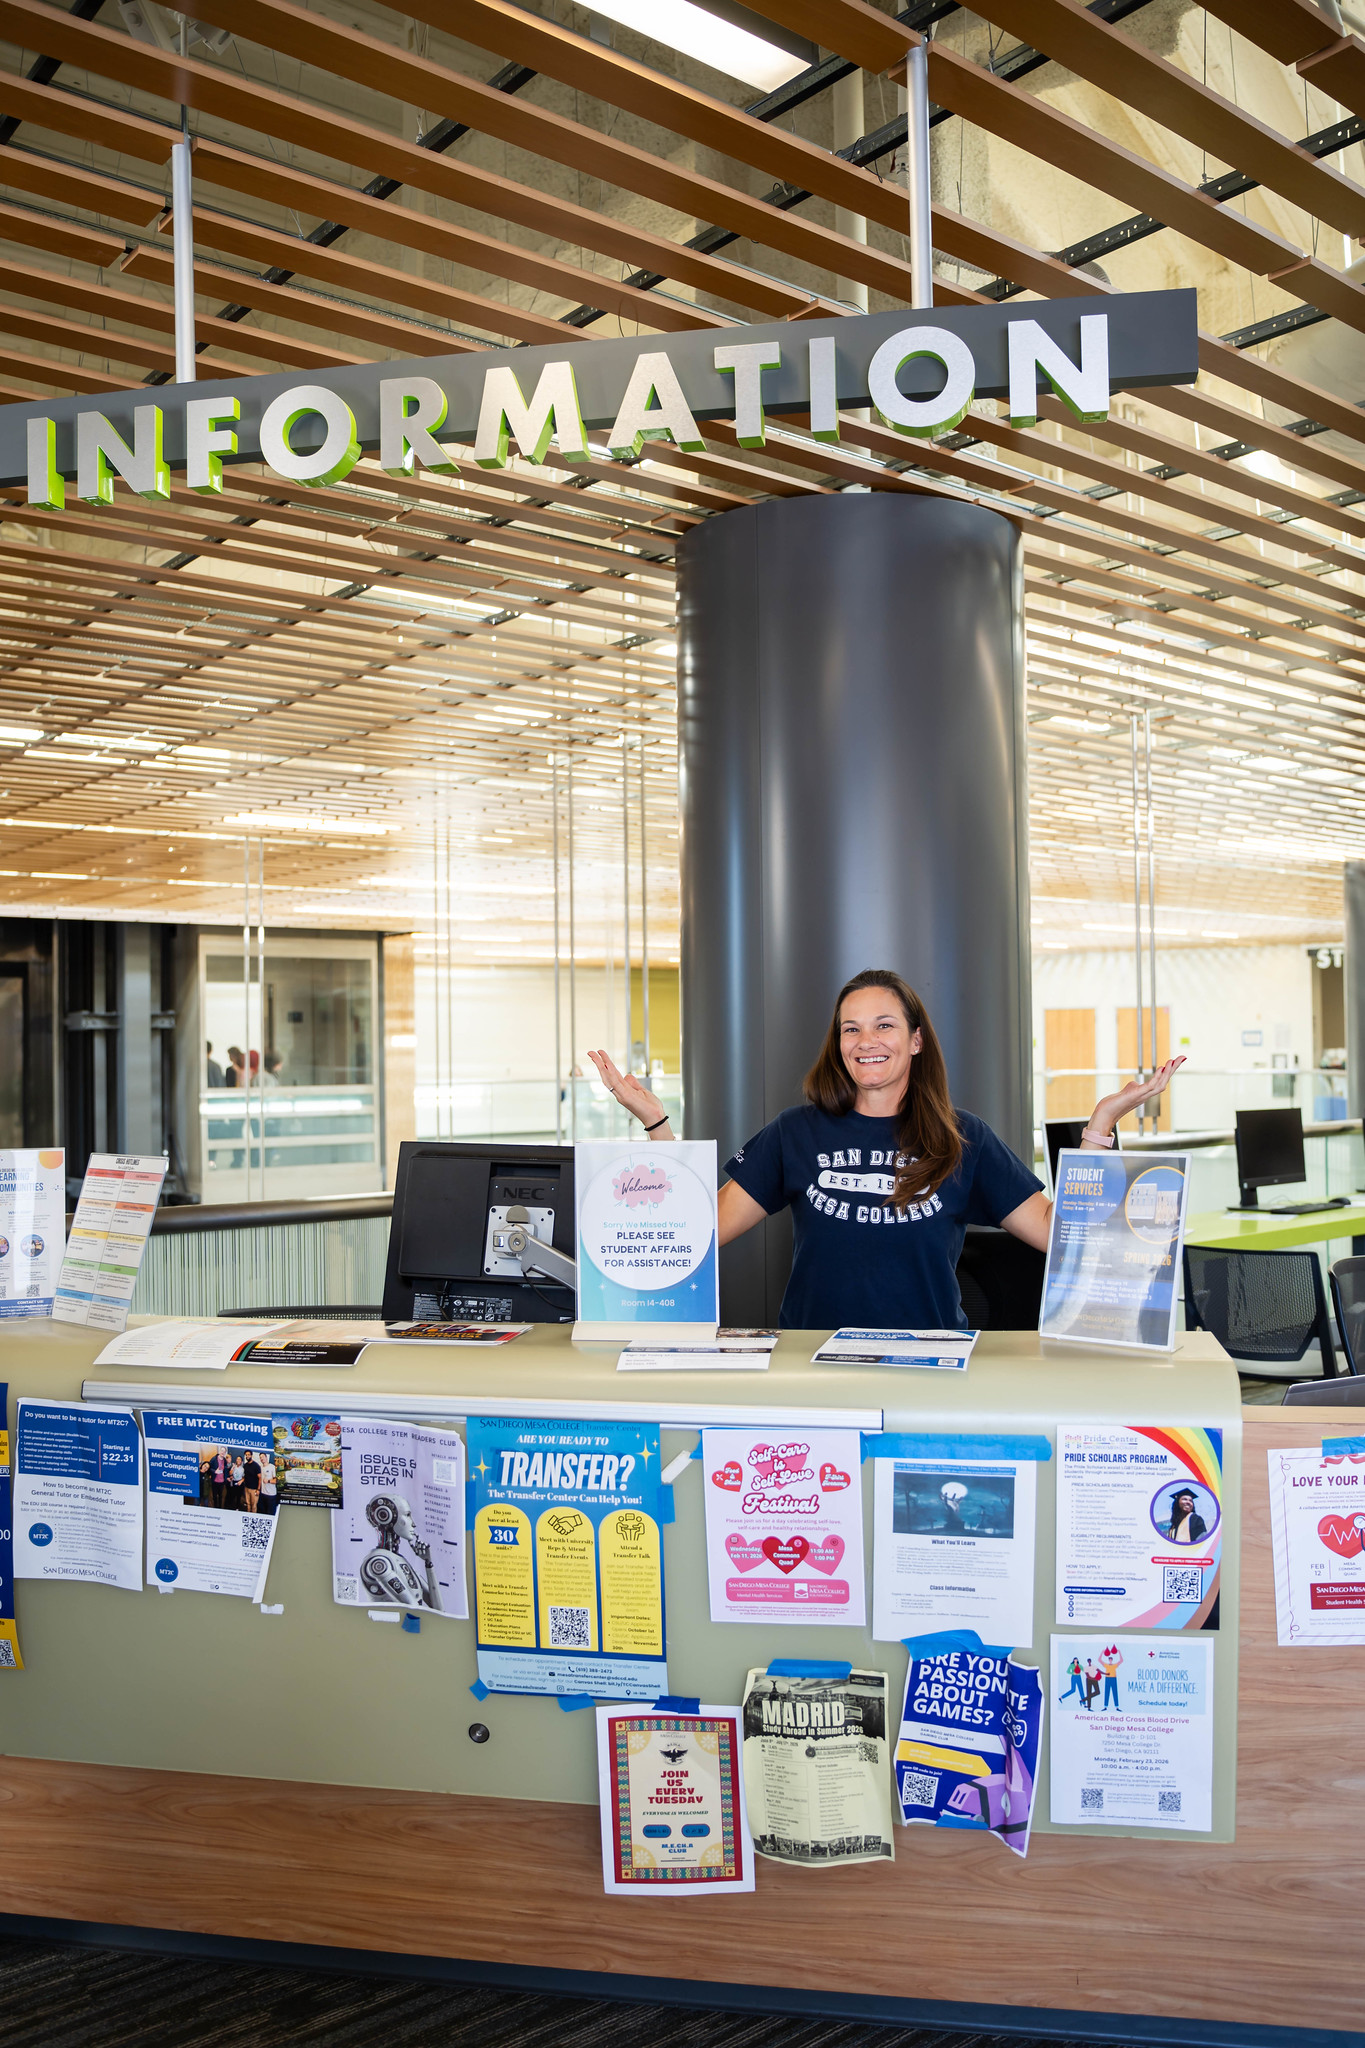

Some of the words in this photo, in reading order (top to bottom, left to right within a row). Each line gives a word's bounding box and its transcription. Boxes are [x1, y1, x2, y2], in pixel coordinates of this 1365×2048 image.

[27, 313, 1110, 511] INFORMATION
[816, 1148, 862, 1169] SAN
[869, 1150, 919, 1169] DIE
[1066, 1168, 1105, 1182] STUDENT
[621, 1178, 665, 1195] Welcome
[828, 1174, 868, 1188] EST.
[877, 1178, 906, 1190] 19
[503, 1187, 545, 1201] NEC
[1063, 1182, 1104, 1196] SERVICES
[806, 1183, 850, 1221] MESA
[855, 1192, 943, 1224] COLLEGE
[603, 1221, 623, 1229] Sorry
[617, 1232, 654, 1240] PLEASE
[656, 1232, 675, 1240] SEE
[600, 1245, 646, 1253] STUDENT
[650, 1245, 692, 1253] AFFAIRS
[604, 1259, 624, 1267] FOR
[627, 1259, 691, 1267] ASSISTANCE!
[621, 1299, 646, 1307] Room
[82, 1416, 96, 1424] tutor
[107, 1419, 129, 1427] MT2C?
[157, 1417, 184, 1426] FREE
[186, 1418, 217, 1428] MT2C
[219, 1420, 268, 1436] Tutoring
[480, 1418, 497, 1428] SAN
[498, 1419, 524, 1430] DIEGO
[524, 1421, 547, 1430] MESA
[547, 1421, 580, 1430] COLLEGE
[195, 1434, 209, 1442] SAN
[208, 1435, 228, 1444] DIEGO
[227, 1437, 244, 1446] MESA
[243, 1439, 268, 1447] COLLEGE
[342, 1427, 355, 1435] ESA
[358, 1428, 387, 1436] COLLEGE
[391, 1430, 408, 1438] STEM
[411, 1433, 436, 1444] READERS
[439, 1438, 457, 1447] CLUB
[517, 1434, 537, 1444] ARE
[538, 1435, 557, 1445] YOU
[557, 1436, 592, 1445] READY
[593, 1437, 609, 1446] TO
[102, 1453, 134, 1463] $22.31
[151, 1452, 169, 1460] Mesa
[169, 1454, 197, 1463] Tutoring
[360, 1454, 407, 1467] ISSUES
[409, 1459, 417, 1468] &
[748, 1443, 810, 1466] Self-Care
[1064, 1453, 1086, 1462] PRIDE
[1089, 1453, 1128, 1463] SCHOLARS
[1130, 1455, 1168, 1464] PROGRAM
[163, 1462, 199, 1472] Computing
[500, 1451, 635, 1491] TRANSFER?
[772, 1458, 786, 1471] is
[162, 1471, 187, 1479] Centers
[360, 1464, 399, 1477] IDEAS
[402, 1468, 414, 1479] IN
[360, 1476, 397, 1487] STEM
[751, 1468, 814, 1491] Self-Love
[1292, 1476, 1323, 1487] LOVE
[1327, 1475, 1359, 1486] YOUR
[31, 1489, 54, 1497] General
[81, 1493, 108, 1504] Embedded
[110, 1498, 126, 1506] Tutor
[487, 1489, 505, 1498] The
[506, 1490, 546, 1500] Transfer
[547, 1493, 578, 1501] Center
[579, 1494, 597, 1503] Can
[599, 1495, 620, 1506] Help
[622, 1496, 642, 1504] You!
[742, 1492, 819, 1515] Festival
[494, 1529, 514, 1543] 30
[43, 1566, 57, 1574] SAN
[57, 1566, 79, 1576] DIEGO
[78, 1569, 95, 1578] MESA
[95, 1570, 117, 1581] COLLEGE
[919, 1652, 961, 1668] ARE
[965, 1654, 1008, 1676] YOU
[1137, 1669, 1159, 1681] BLOOD
[1161, 1669, 1189, 1681] DONORS
[918, 1665, 1029, 1711] PASSIONTE
[1128, 1681, 1147, 1693] MAKE
[1150, 1682, 1155, 1693] A
[1156, 1682, 1198, 1694] DIFFERENCE.
[914, 1681, 989, 1708] ABOUT
[1168, 1700, 1188, 1708] today!
[761, 1700, 845, 1727] MADRID
[912, 1697, 995, 1726] GAMES?
[1074, 1714, 1109, 1722] American
[762, 1726, 781, 1734] Study
[782, 1727, 806, 1735] Abroad
[808, 1727, 814, 1735] in
[815, 1726, 845, 1734] Summer
[847, 1726, 864, 1734] 2026
[1105, 1725, 1125, 1733] Diego
[1147, 1726, 1174, 1734] College
[660, 1770, 689, 1778] JOIN
[656, 1787, 695, 1795] EVERY
[648, 1796, 703, 1804] TUESDAY
